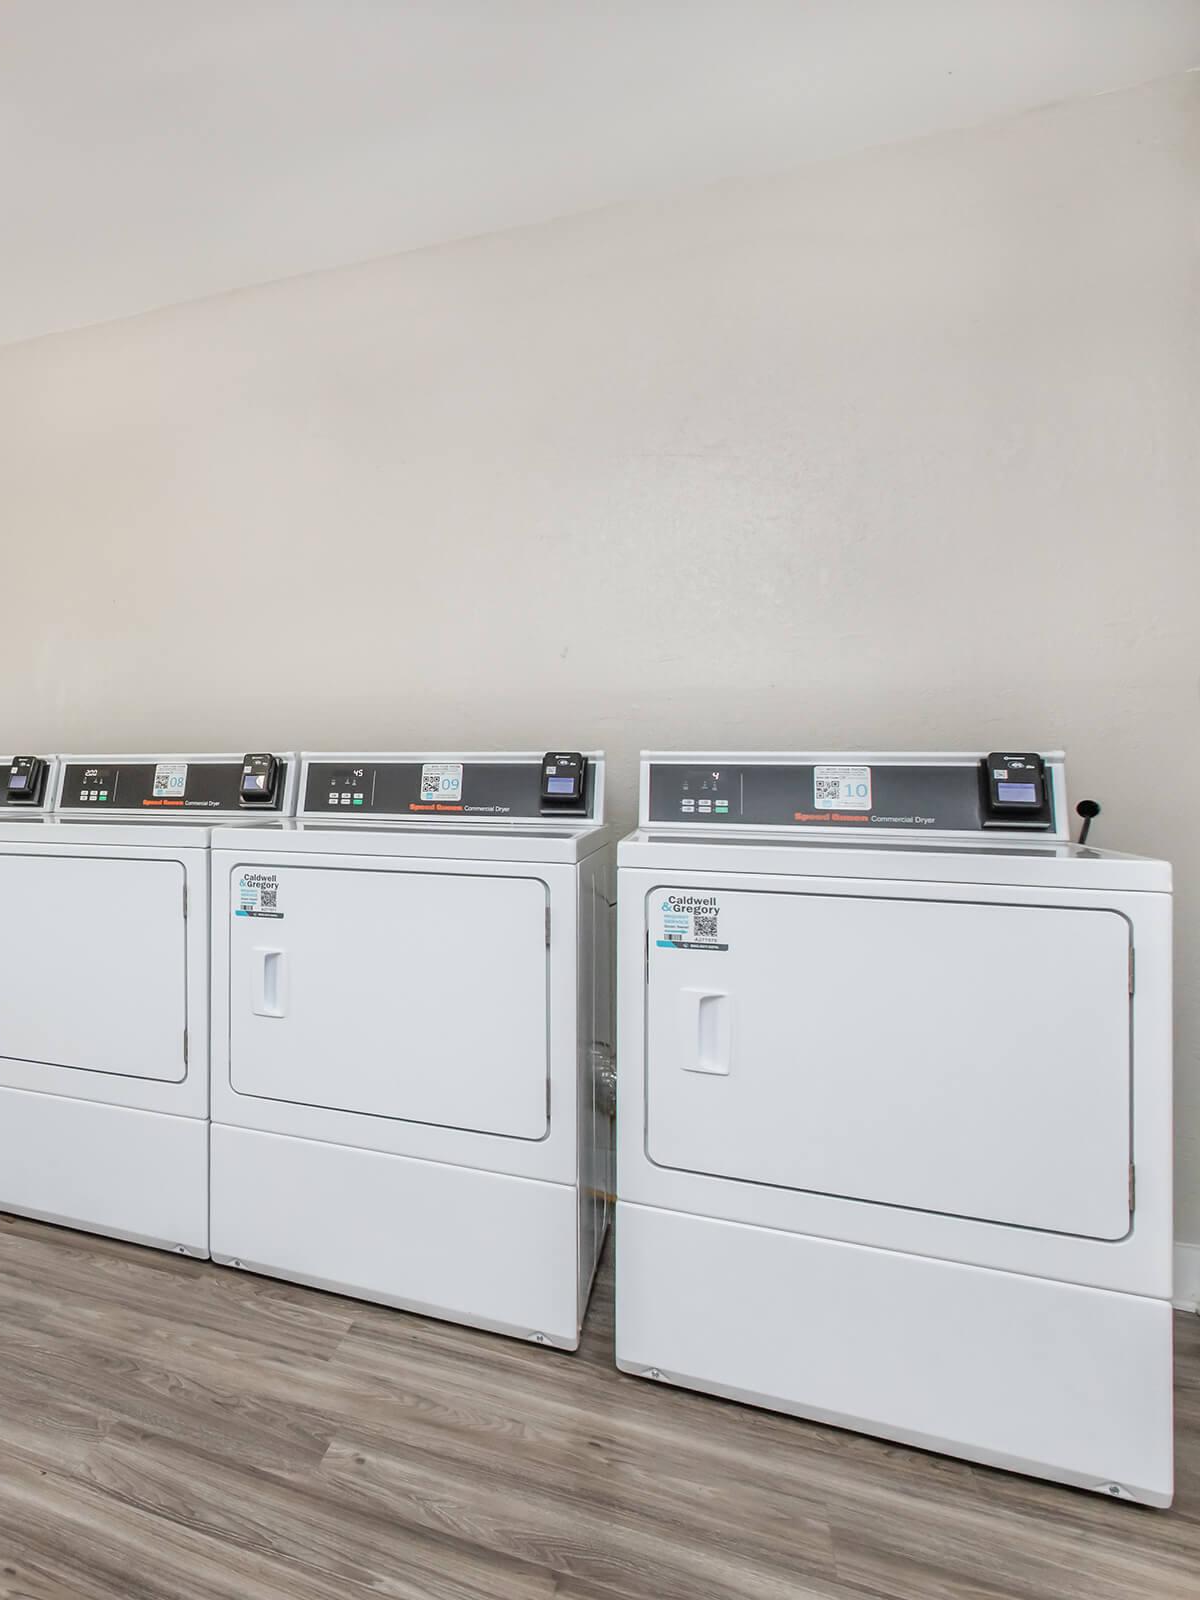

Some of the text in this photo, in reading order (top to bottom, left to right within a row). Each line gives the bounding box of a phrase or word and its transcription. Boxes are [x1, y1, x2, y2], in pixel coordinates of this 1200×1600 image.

[169, 776, 184, 788] 08
[441, 778, 460, 791] 09
[846, 783, 868, 798] 10
[208, 800, 220, 808] Dryer
[464, 804, 494, 812] Commercial
[495, 805, 510, 813] Dryer
[870, 815, 913, 823] Commercial
[914, 816, 935, 825] Dryer
[244, 873, 277, 882] Caldwell
[668, 895, 717, 906] Caldwell
